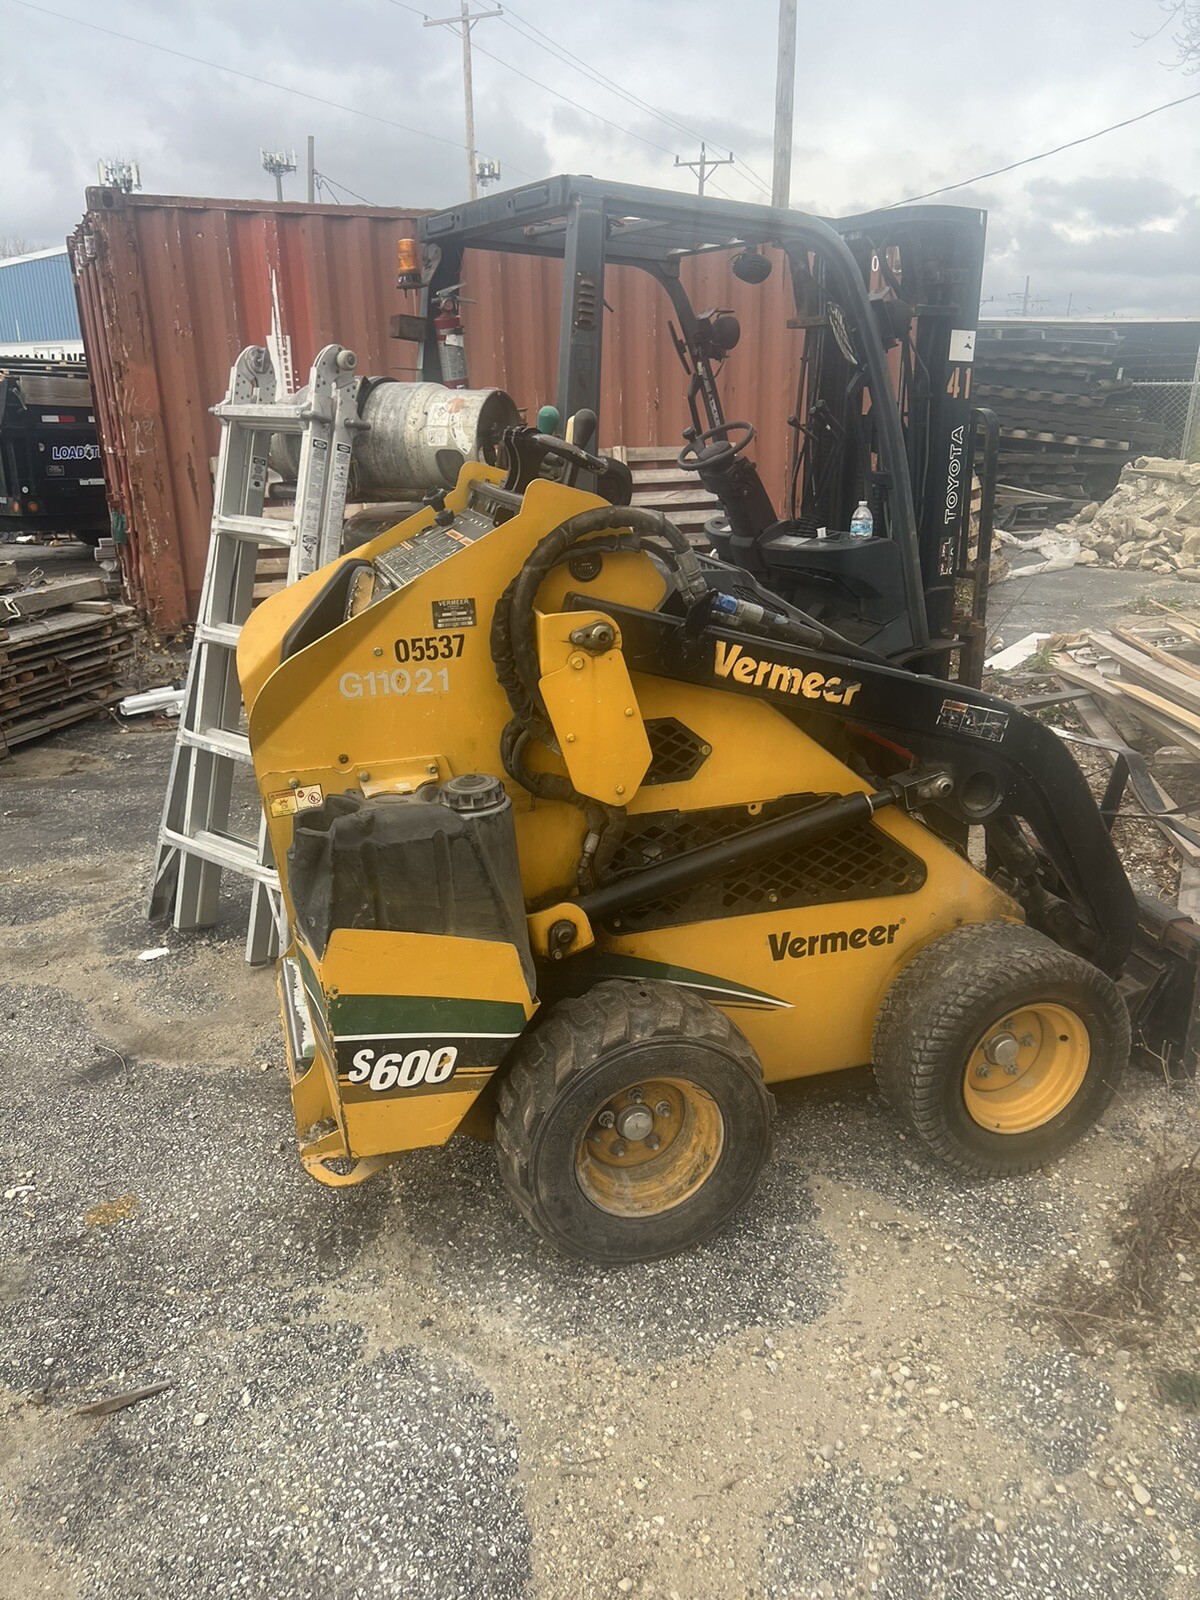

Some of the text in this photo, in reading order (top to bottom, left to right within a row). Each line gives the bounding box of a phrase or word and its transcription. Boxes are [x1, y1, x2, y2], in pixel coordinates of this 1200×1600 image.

[946, 367, 972, 399] 41
[52, 446, 85, 460] LOAD
[944, 425, 964, 524] TOYOTA
[437, 598, 469, 606] VERMEER
[394, 634, 465, 663] 05537
[714, 640, 862, 706] Vermeer
[348, 1046, 458, 1091] S600
